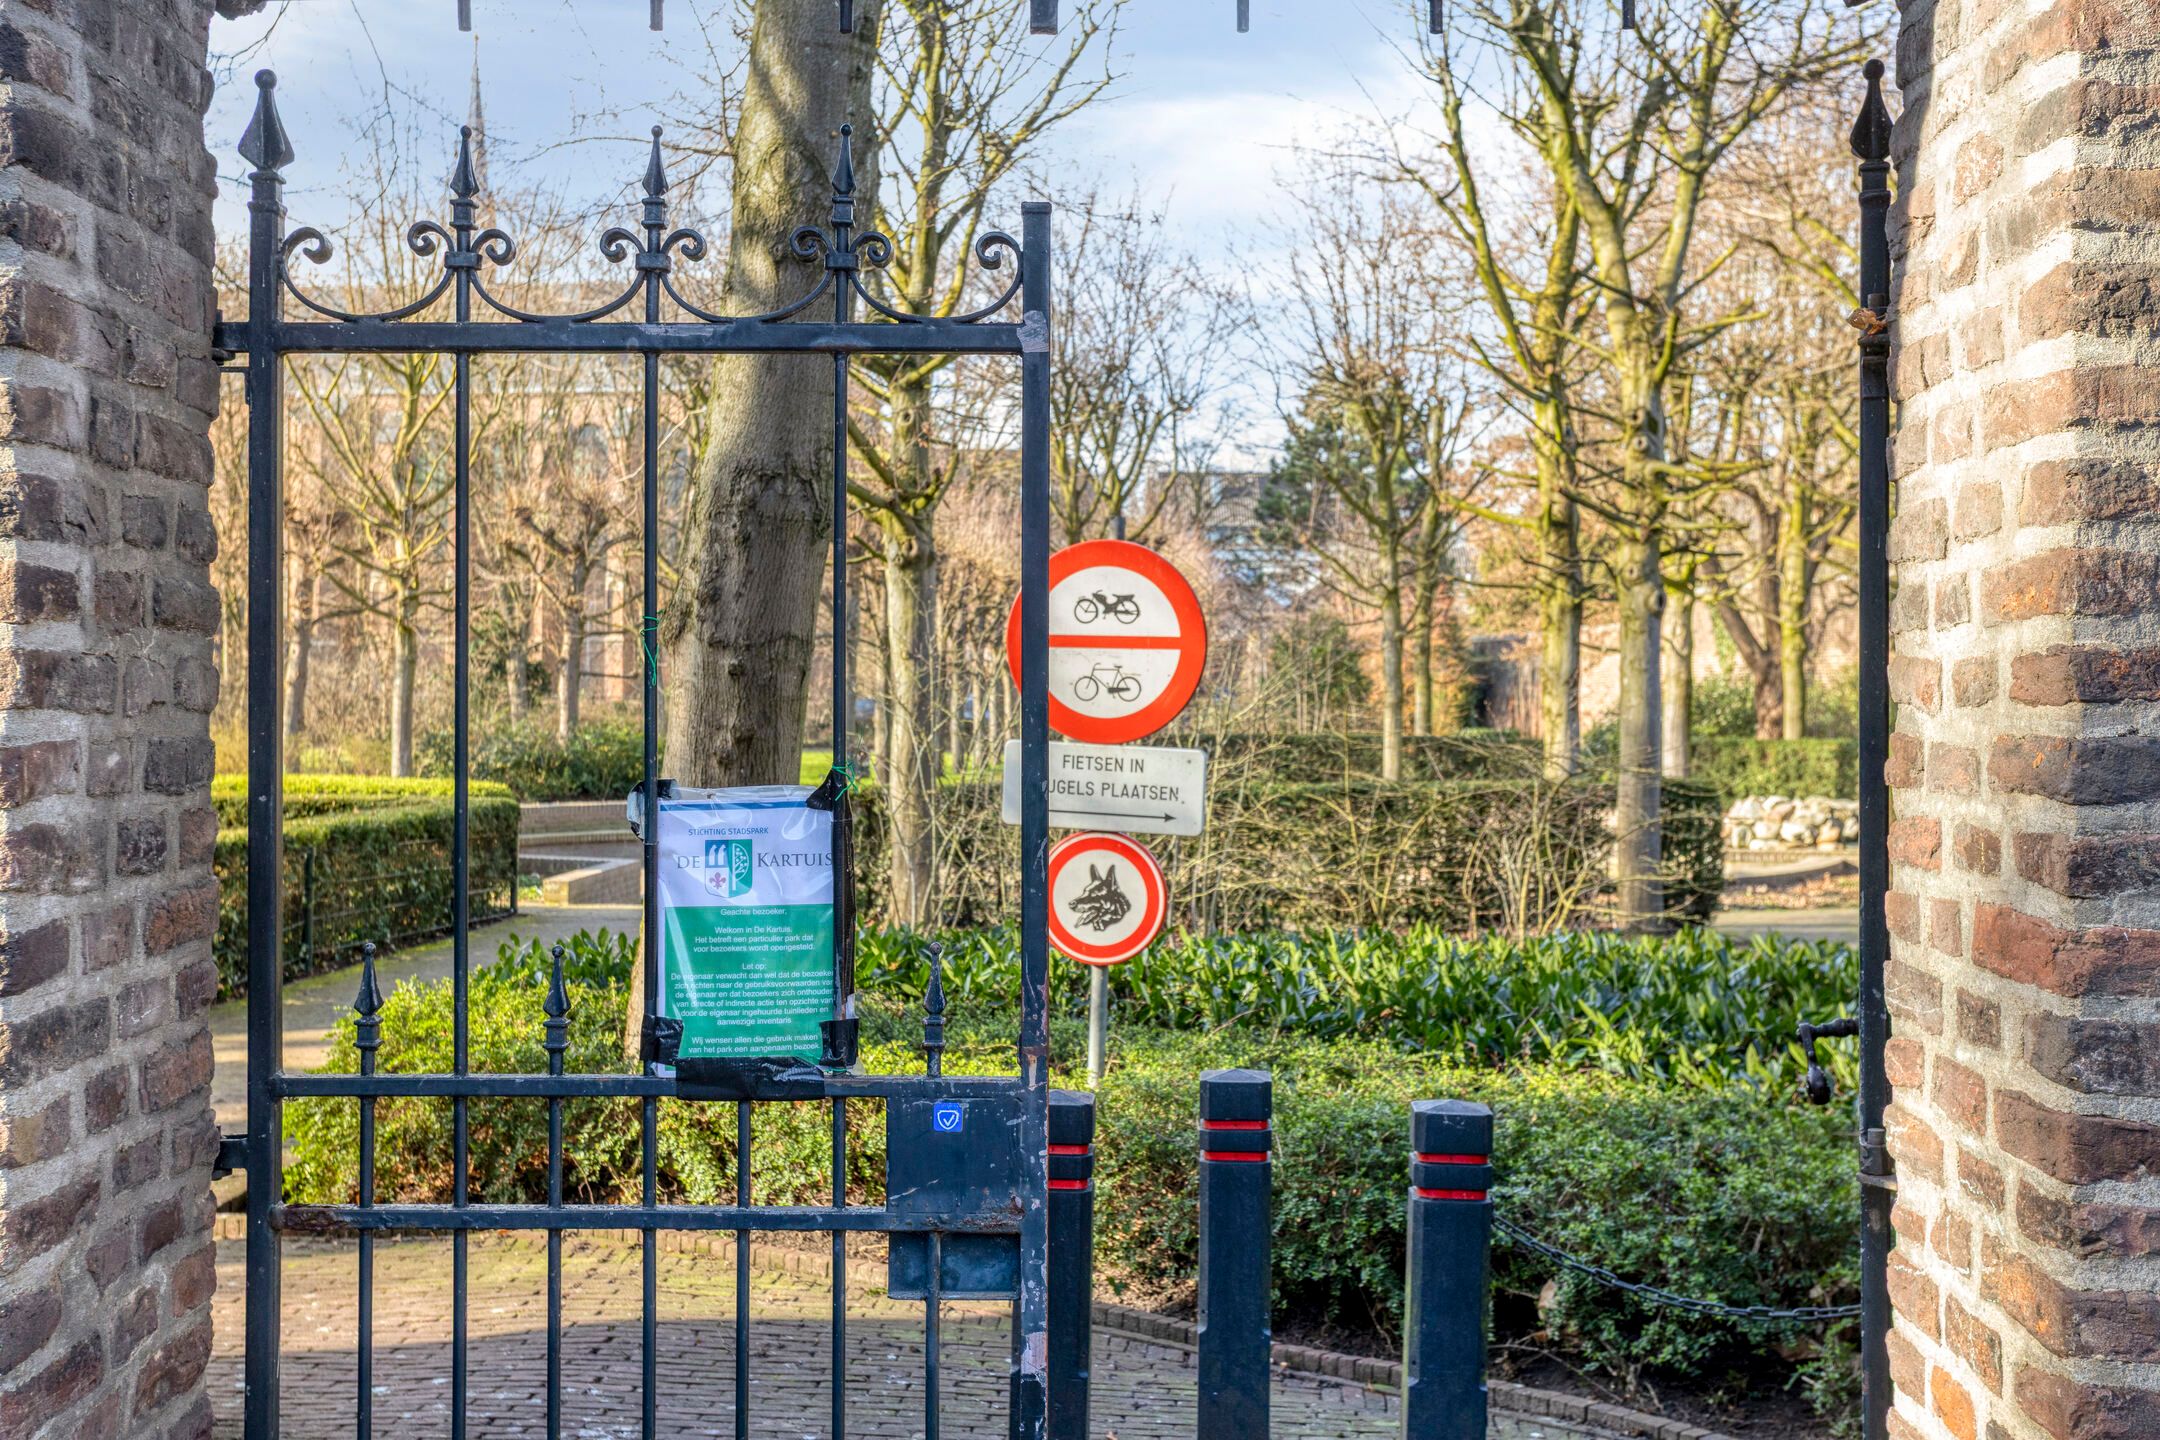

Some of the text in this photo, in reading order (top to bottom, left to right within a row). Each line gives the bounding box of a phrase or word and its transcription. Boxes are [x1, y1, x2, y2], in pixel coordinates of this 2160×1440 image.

[1062, 754, 1145, 773] FIETSEN IN
[688, 827, 769, 836] STICHTING STADSPARK
[677, 855, 701, 869] DE
[720, 908, 751, 916] Geachte
[714, 926, 744, 934] Welkom
[748, 935, 783, 943] particulier
[784, 934, 800, 943] park
[801, 934, 814, 942] dat
[748, 944, 769, 952] wordt
[755, 963, 767, 971] op:
[744, 980, 820, 989] gebruiksvoorwaarden
[742, 989, 779, 997] bezoekers
[725, 999, 755, 1007] indirecte
[789, 997, 819, 1006] opzichte
[709, 1009, 740, 1018] eigenaar
[741, 1008, 782, 1017] ingehuurde
[784, 1007, 817, 1015] tuinlieden
[717, 1018, 755, 1026] aanwezige
[691, 1036, 703, 1045] Wij
[766, 1035, 793, 1043] gebruik
[716, 1046, 733, 1054] park
